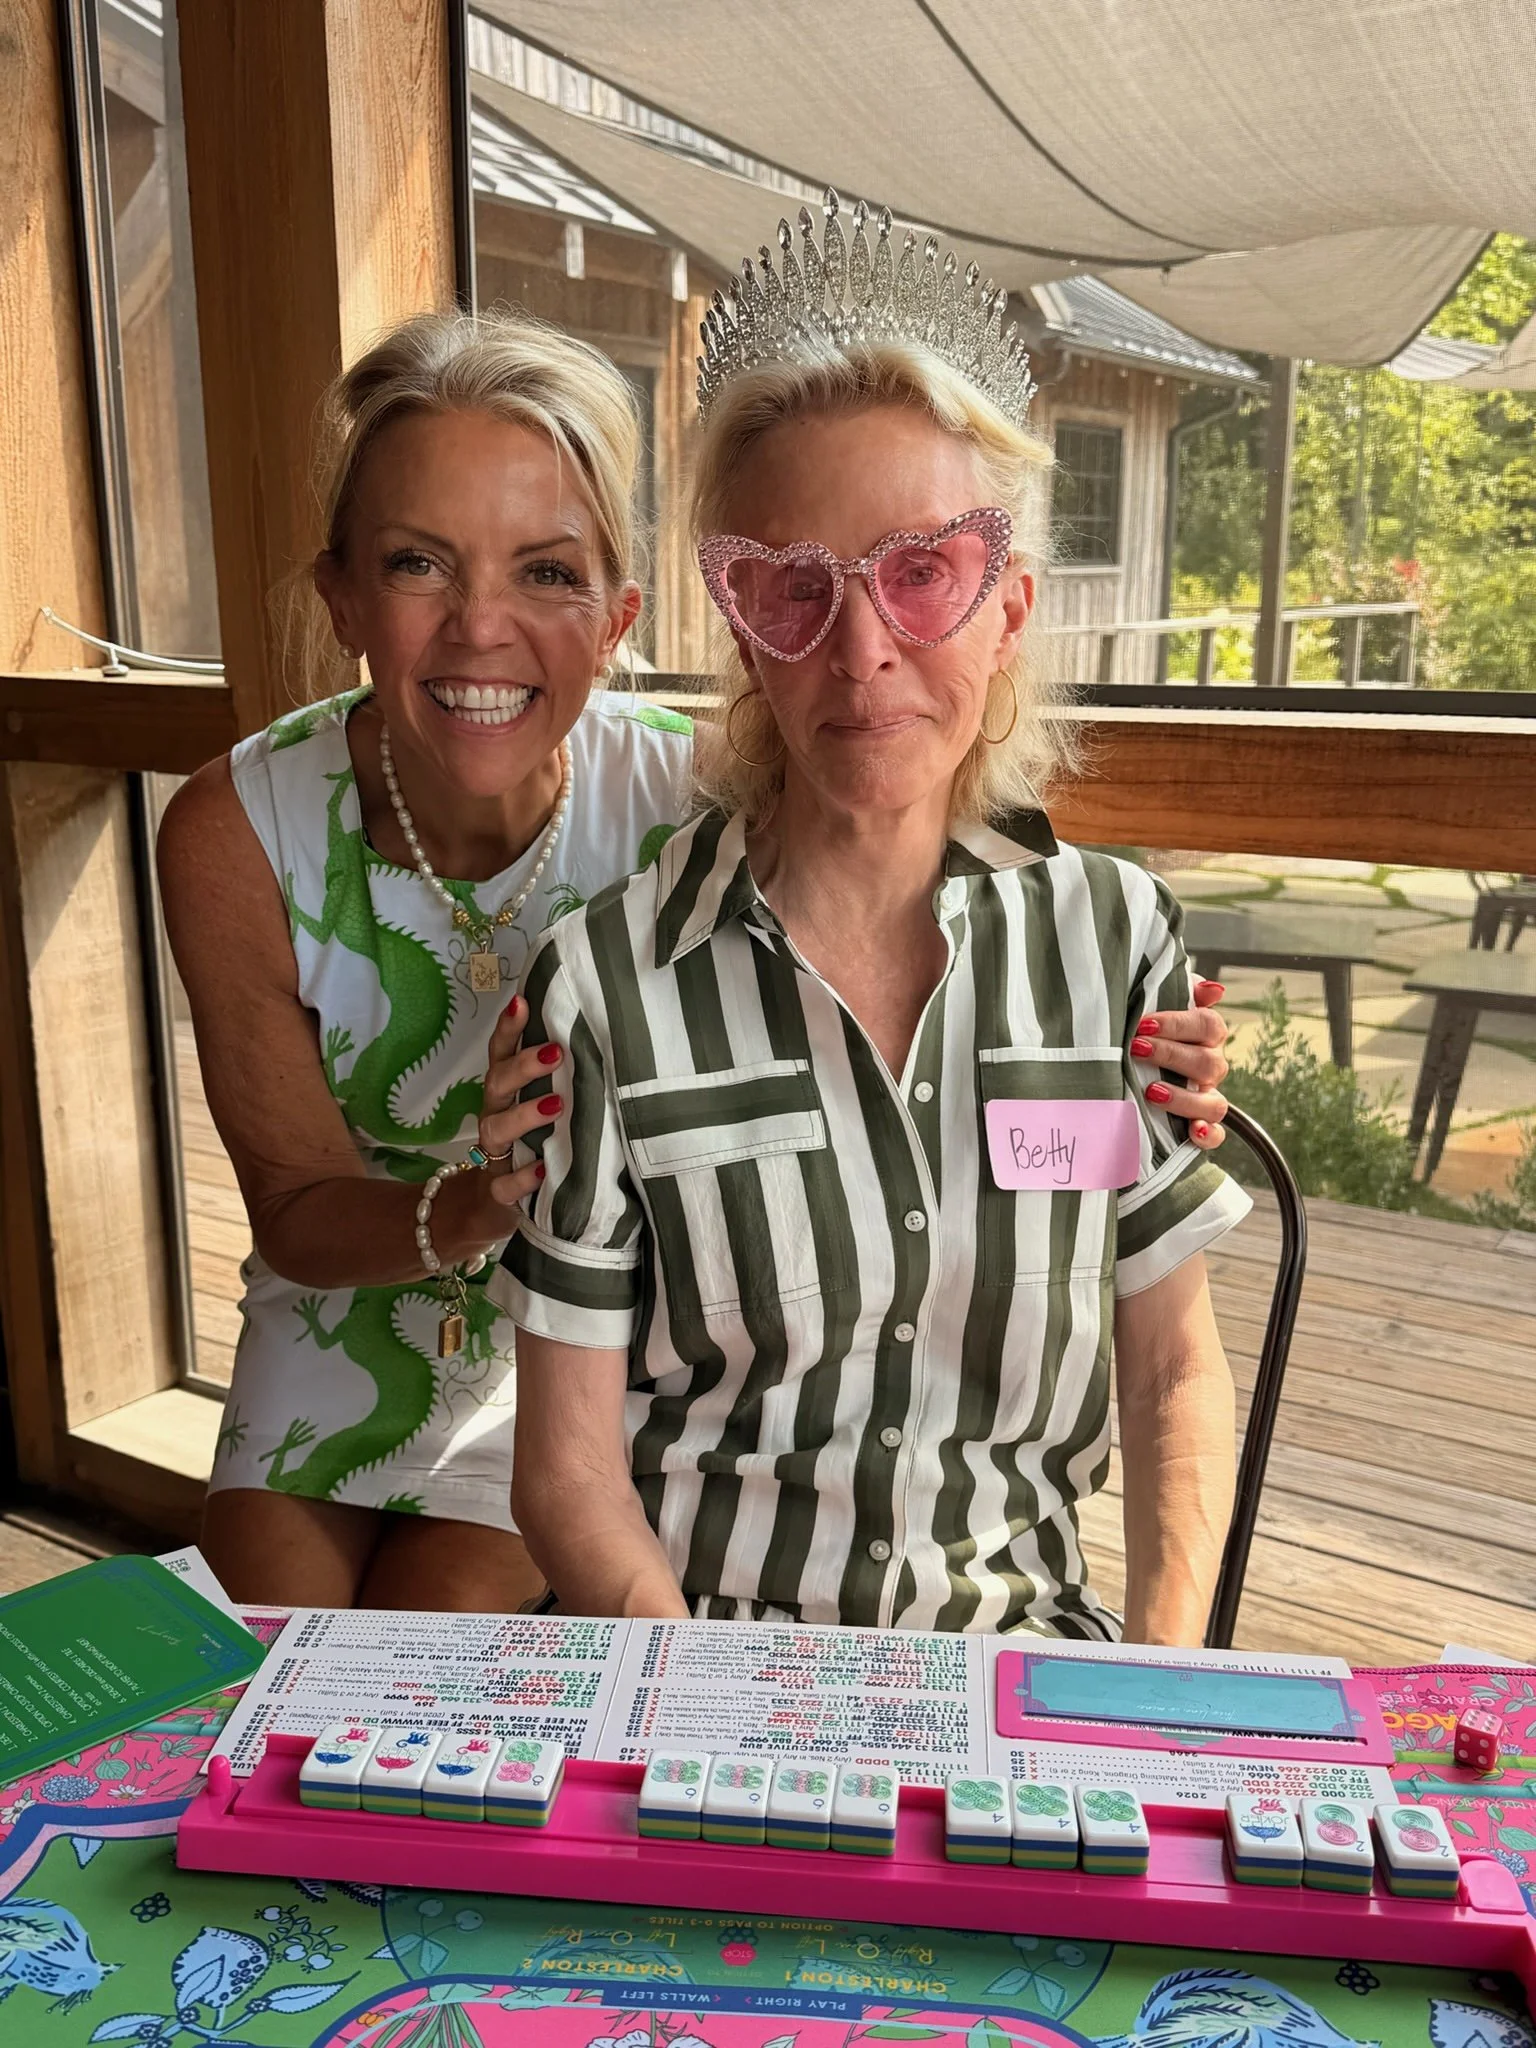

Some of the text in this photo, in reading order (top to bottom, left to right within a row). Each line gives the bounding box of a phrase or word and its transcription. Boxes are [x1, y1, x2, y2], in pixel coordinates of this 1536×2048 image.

[1010, 1128, 1076, 1184] Betty
[1428, 1695, 1496, 1706] CRAKS
[767, 1743, 847, 1752] CONSECUTIVE
[855, 1757, 888, 1765] DDDD
[1238, 1763, 1273, 1772] NEWS
[1277, 1765, 1301, 1773] 666
[1247, 1771, 1279, 1779] 6666
[1283, 1773, 1308, 1781] 222
[1312, 1774, 1345, 1783] 2026
[1241, 1779, 1269, 1787] DDD
[1273, 1780, 1304, 1788] 2222
[1308, 1781, 1336, 1789] DDD
[1339, 1783, 1371, 1791] 2026
[1175, 1791, 1206, 1799] 2026
[1247, 1786, 1280, 1795] 6666
[1284, 1788, 1316, 1796] 2222
[1348, 1791, 1374, 1799] 222
[992, 1813, 1004, 1824] 4
[1058, 1818, 1071, 1828] 4
[1240, 1815, 1289, 1826] JOKER
[1128, 1823, 1140, 1833] 4
[1356, 1840, 1364, 1852] 2
[1440, 1845, 1449, 1857] 2
[649, 1916, 683, 1925] TILES
[719, 1919, 752, 1927] PASS
[757, 1921, 774, 1929] TO
[781, 1922, 832, 1931] OPTION
[724, 1949, 752, 1959] STOP
[522, 1958, 683, 1976] CHARLESTON 2
[785, 1971, 946, 1993] CHARLESTON 1
[620, 1990, 710, 2003] WALLS LEFT
[755, 1996, 846, 2010] PLAY RIGHT
